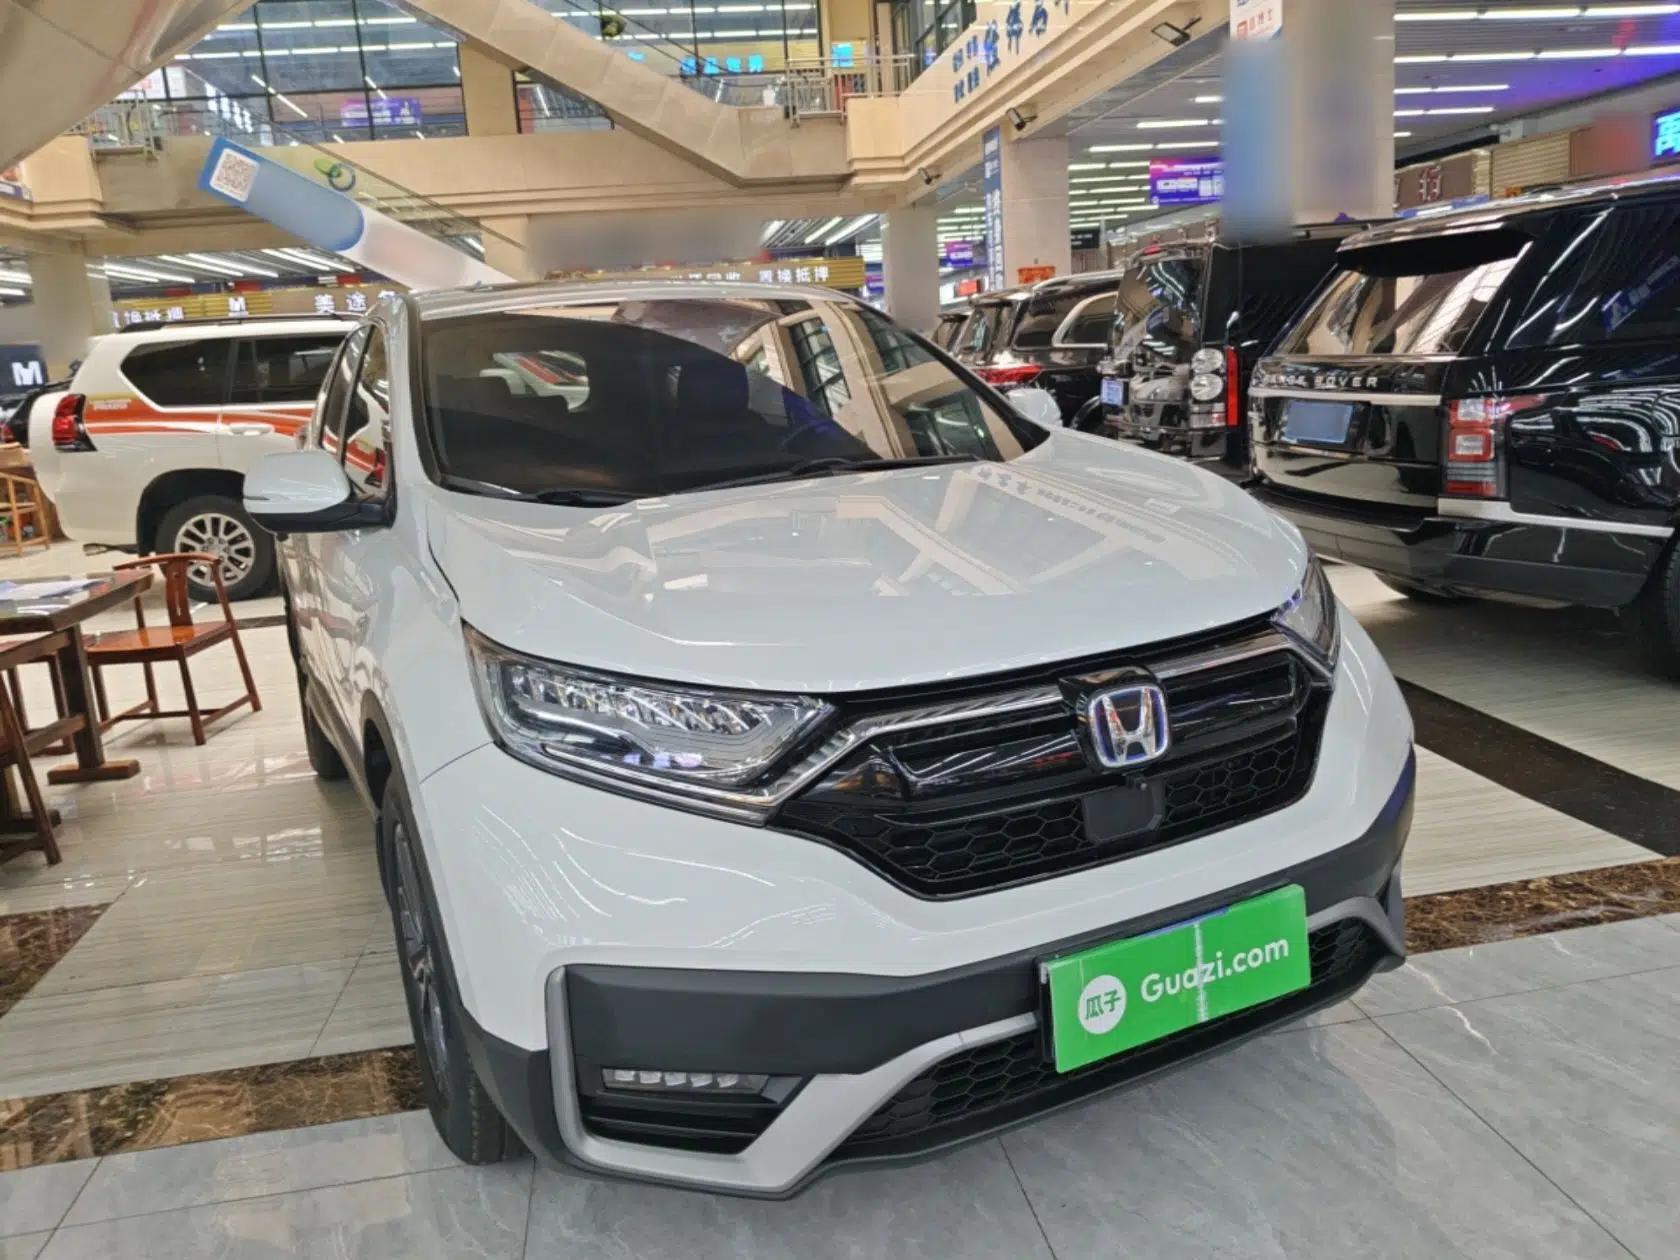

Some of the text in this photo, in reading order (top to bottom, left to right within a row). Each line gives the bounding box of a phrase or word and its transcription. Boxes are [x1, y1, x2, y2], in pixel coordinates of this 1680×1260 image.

[1314, 374, 1379, 389] ROVER
[1140, 937, 1289, 1002] Guazi.com
[1084, 987, 1121, 1020] 瓜子
